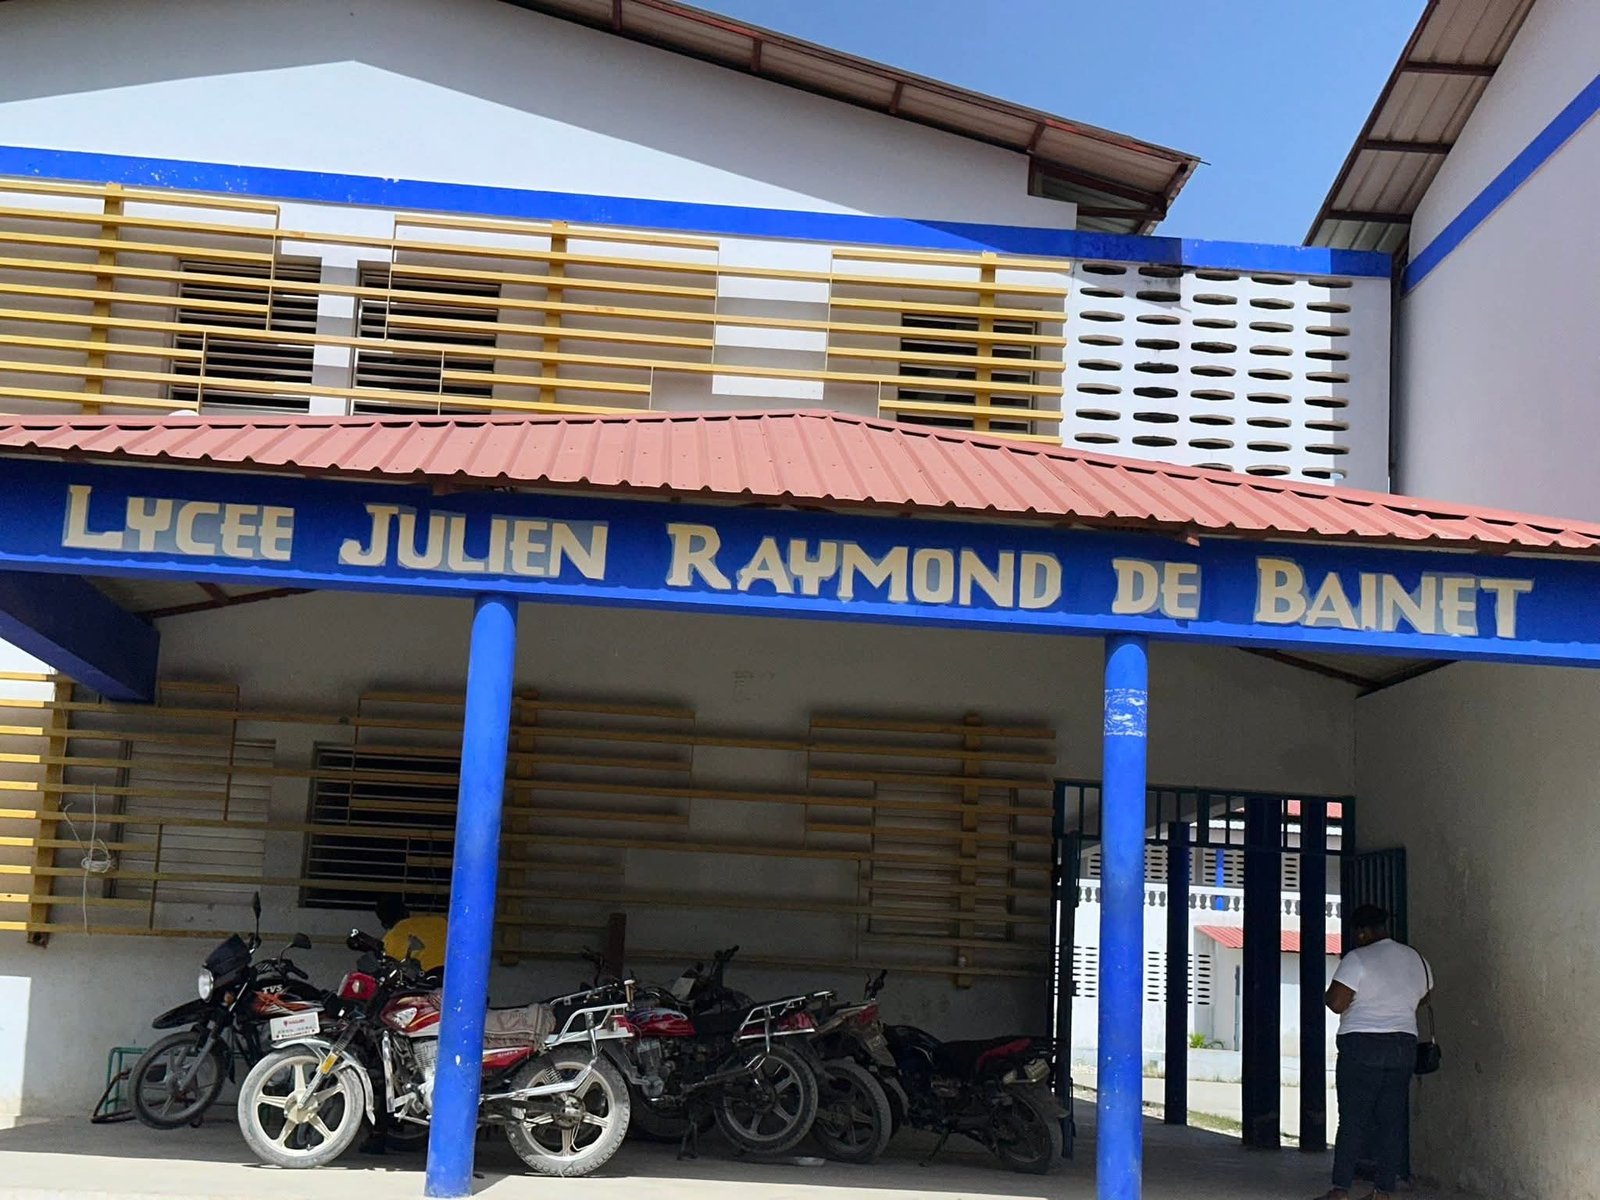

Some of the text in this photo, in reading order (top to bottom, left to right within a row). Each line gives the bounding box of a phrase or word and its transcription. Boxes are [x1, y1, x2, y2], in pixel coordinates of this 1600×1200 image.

[63, 485, 1533, 638] LYCEE JULIEN RAYMOND DE BAINET
[262, 984, 283, 994] TVS
